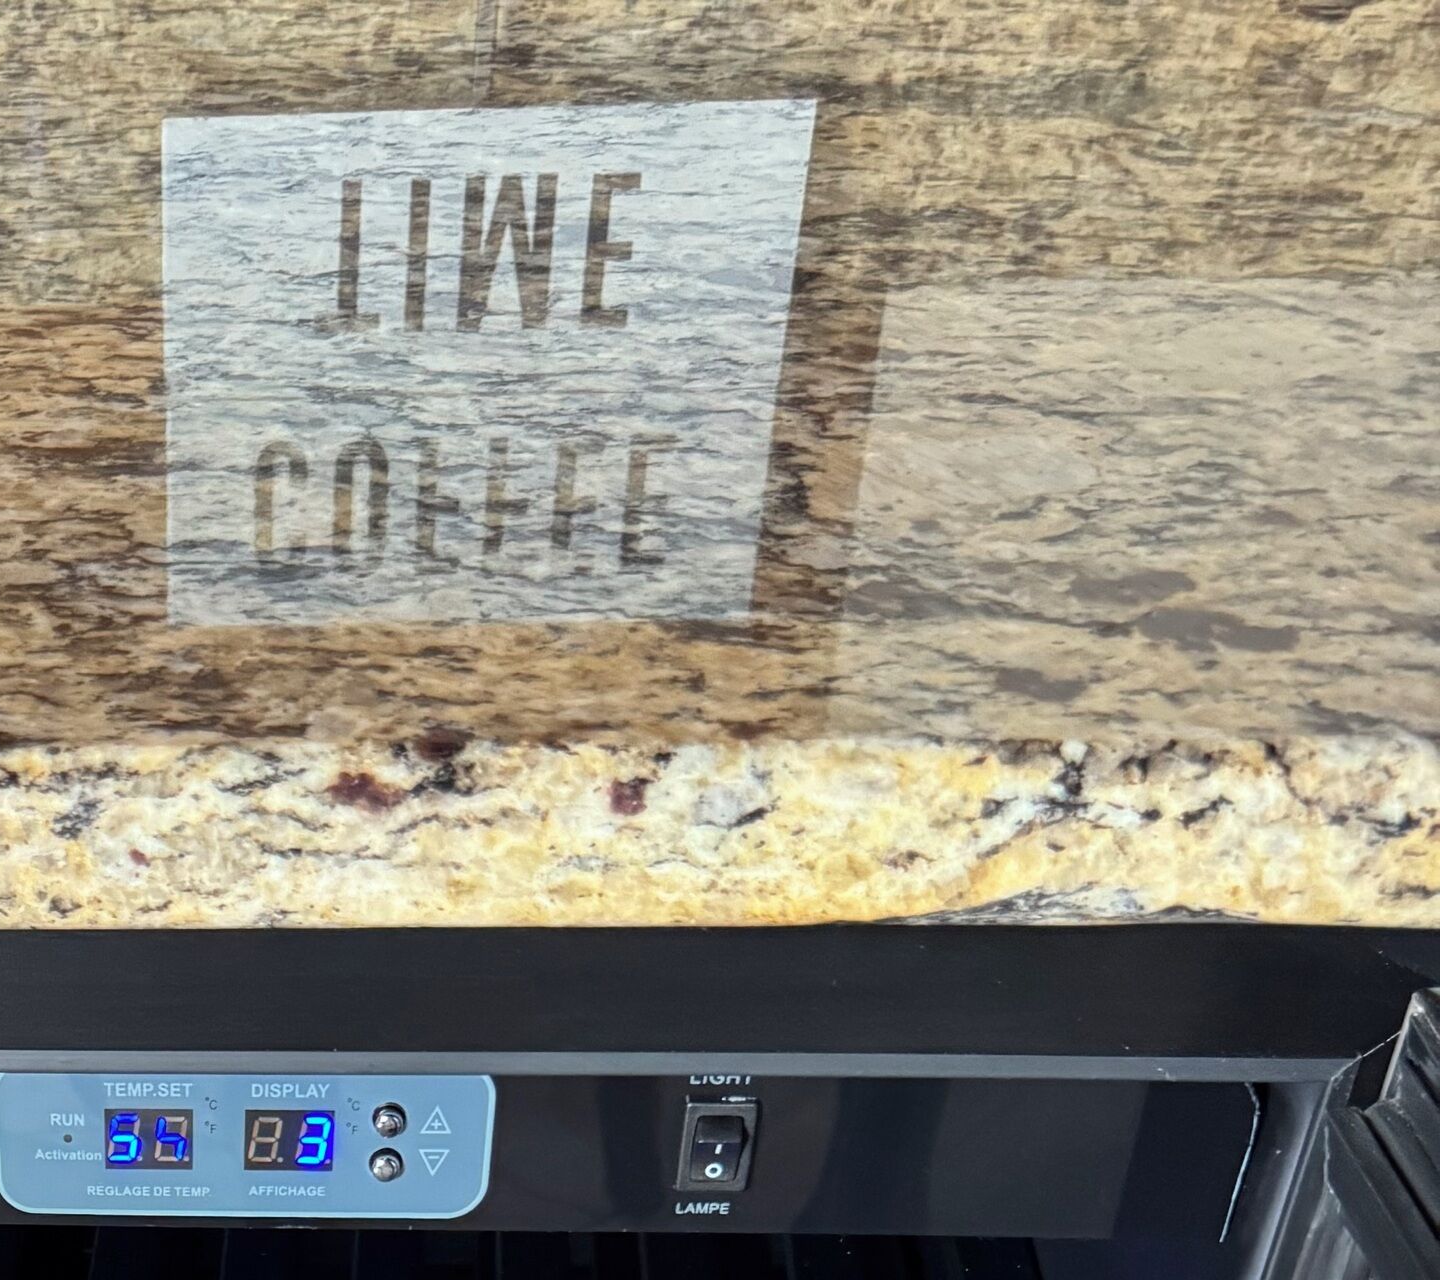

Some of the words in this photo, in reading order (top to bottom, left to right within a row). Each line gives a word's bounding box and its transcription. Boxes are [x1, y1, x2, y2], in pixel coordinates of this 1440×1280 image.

[103, 1082, 193, 1098] TEMP.SET
[250, 1083, 330, 1098] DISPLAY
[49, 1113, 85, 1127] RUN
[34, 1148, 102, 1161] Activation
[153, 1186, 171, 1197] DE
[248, 1185, 326, 1197] AFFICHAGE
[674, 1202, 731, 1215] LAMPE
